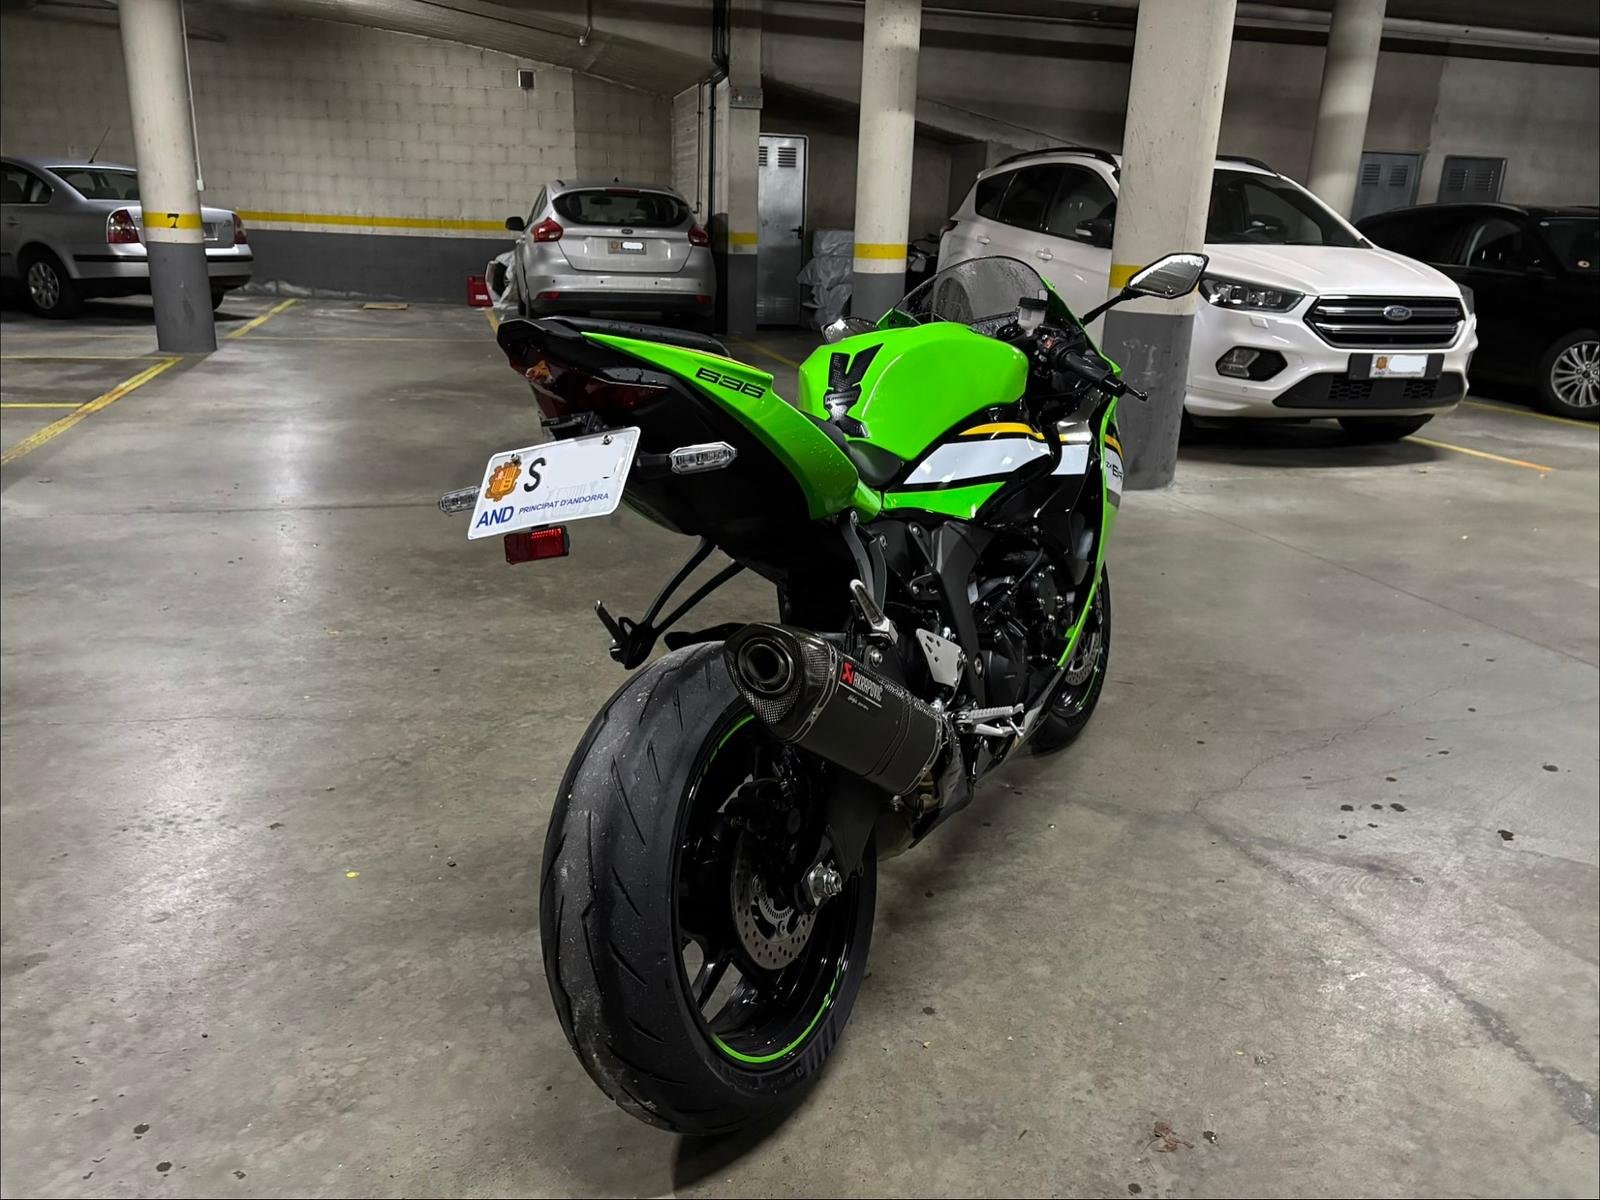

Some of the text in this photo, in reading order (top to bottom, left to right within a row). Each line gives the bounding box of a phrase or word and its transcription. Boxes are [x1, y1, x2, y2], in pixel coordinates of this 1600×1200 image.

[167, 213, 179, 228] 7
[696, 367, 766, 399] 636
[523, 457, 547, 493] S
[476, 492, 610, 529] AND PRINCIPAT D'ANDORRA
